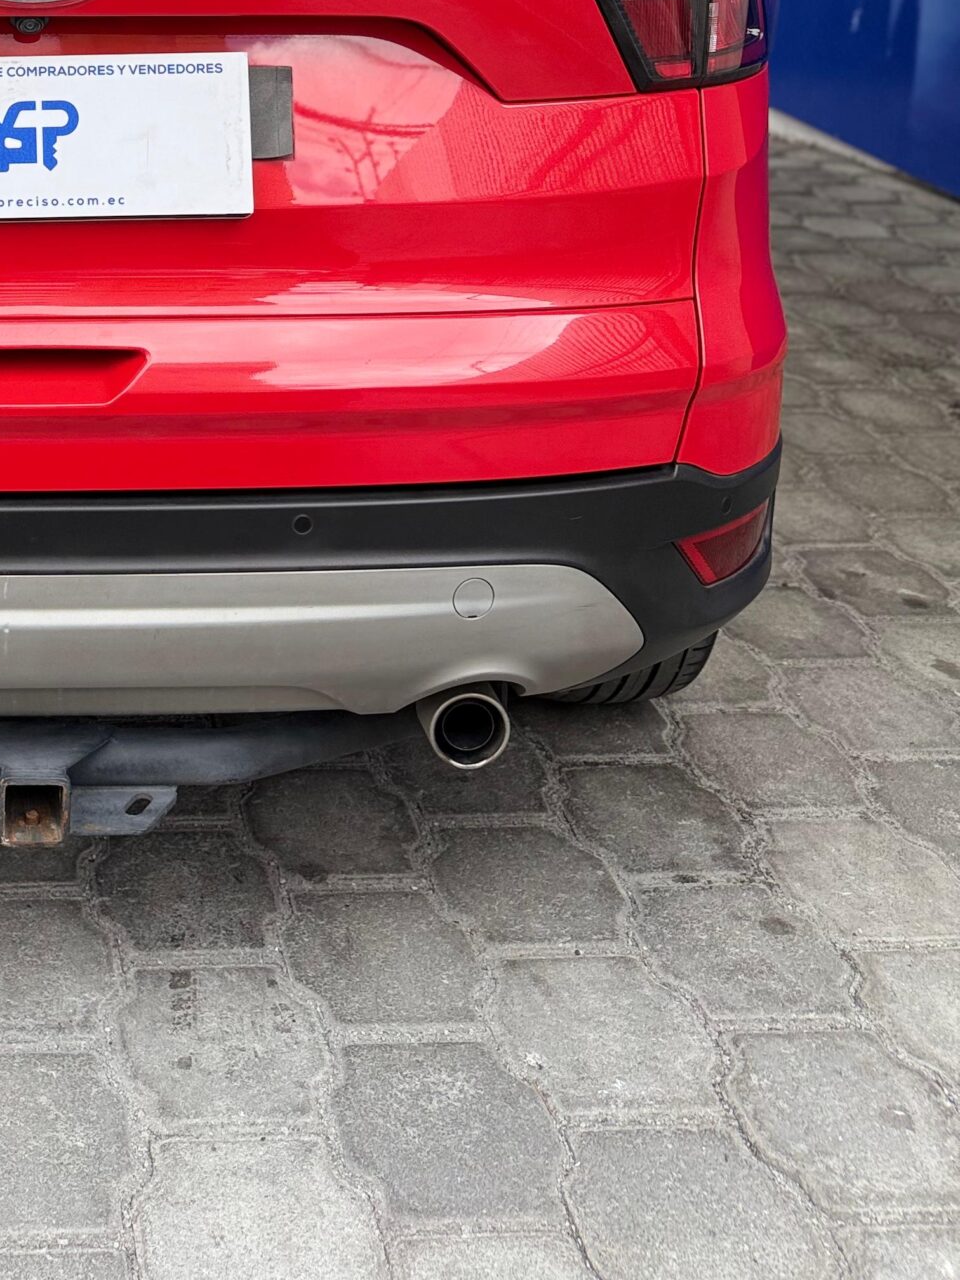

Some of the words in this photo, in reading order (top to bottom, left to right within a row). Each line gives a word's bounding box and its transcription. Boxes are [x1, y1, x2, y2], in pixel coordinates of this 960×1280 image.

[6, 65, 115, 78] COMPRADORES
[117, 65, 126, 76] Y
[128, 63, 224, 76] VENDEDORES
